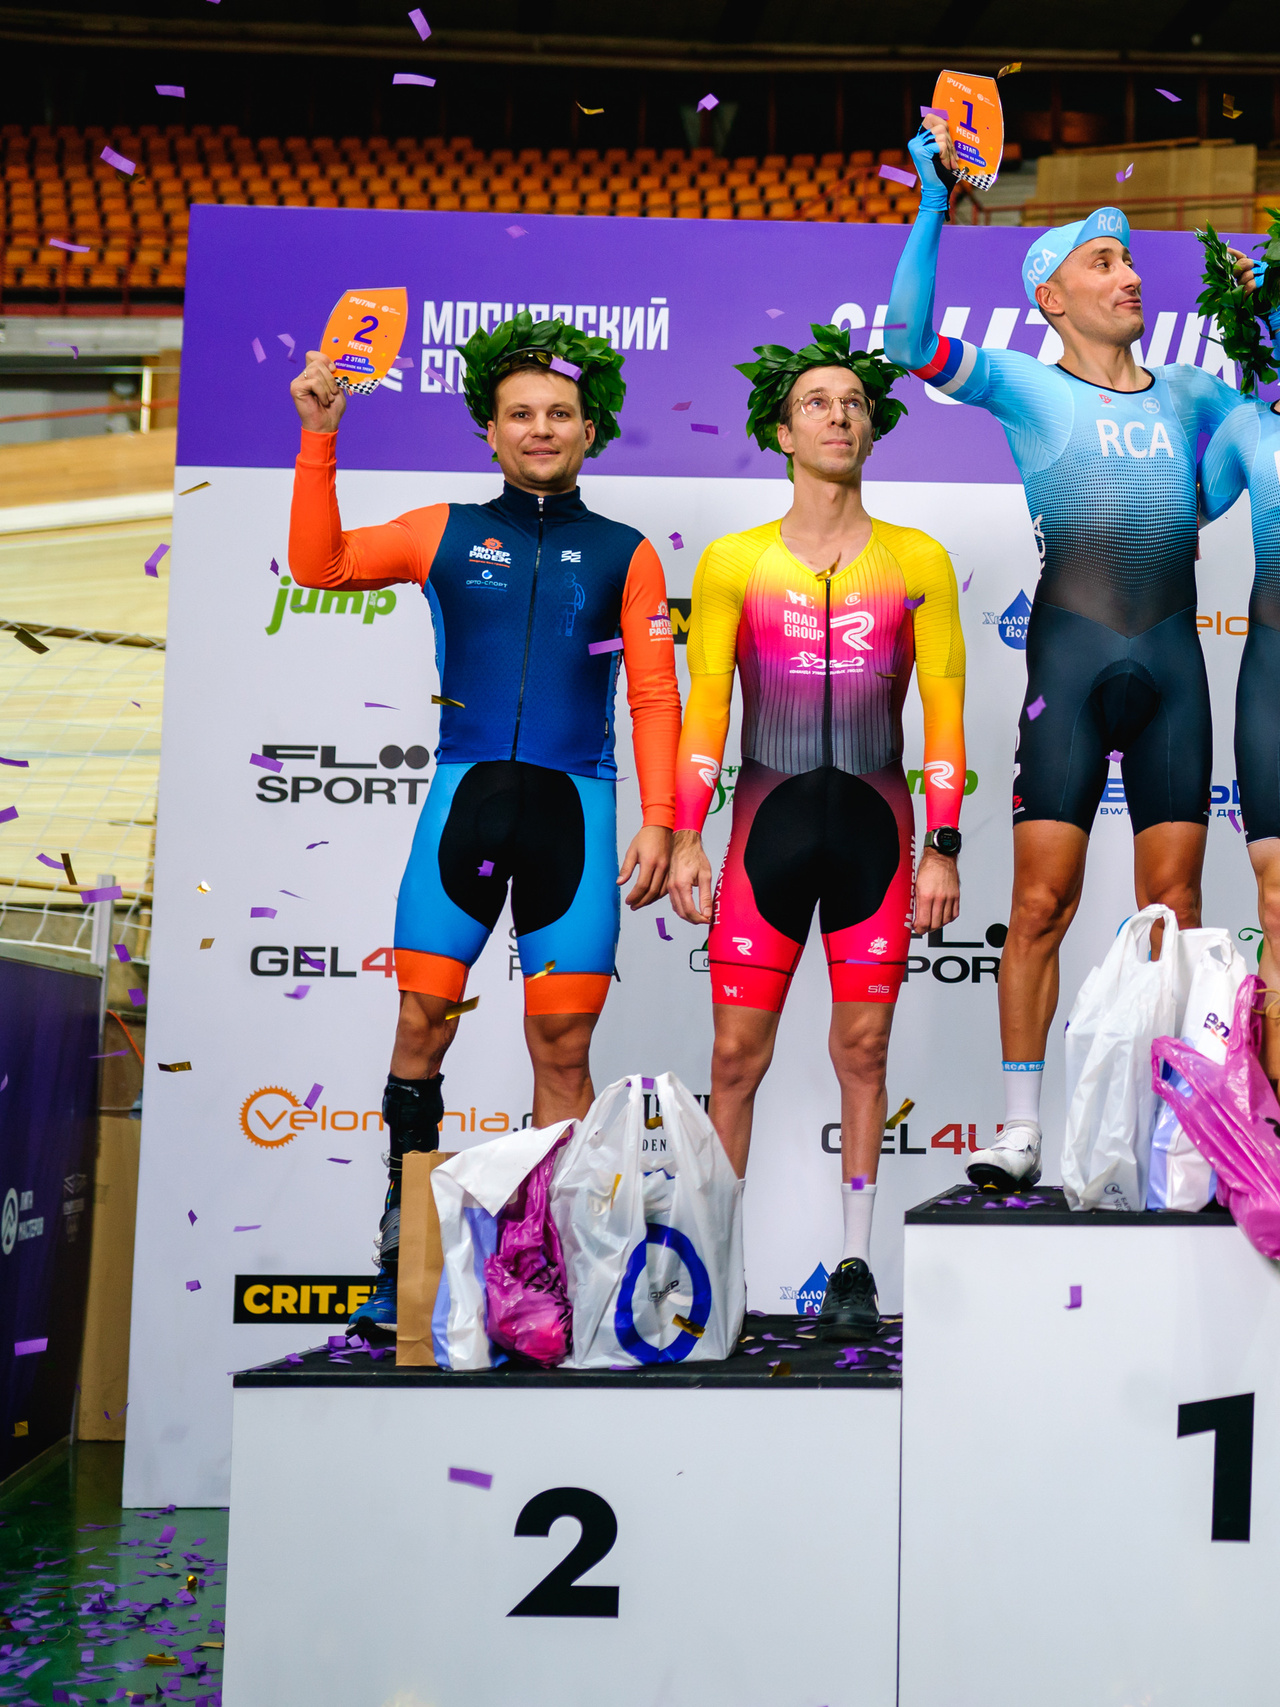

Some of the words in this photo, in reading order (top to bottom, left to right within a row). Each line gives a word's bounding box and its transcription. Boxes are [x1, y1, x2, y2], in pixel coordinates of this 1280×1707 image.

[960, 100, 978, 134] 1
[956, 126, 980, 144] МЕСТО
[1097, 213, 1123, 234] RCA
[1027, 248, 1057, 287] RCA
[353, 315, 379, 345] 2
[422, 297, 669, 350] МОССКИЙ
[347, 341, 373, 354] МЕСТО
[1096, 419, 1174, 458] RCA
[265, 576, 397, 636] jump
[784, 610, 817, 628] ROAD
[784, 624, 824, 641] GROUP
[256, 776, 429, 804] SPORT
[251, 946, 396, 978] GEL4
[642, 1139, 667, 1151] DEN
[243, 1284, 380, 1314] CRIT.E
[1177, 1393, 1256, 1542] 1
[508, 1488, 620, 1618] 2
